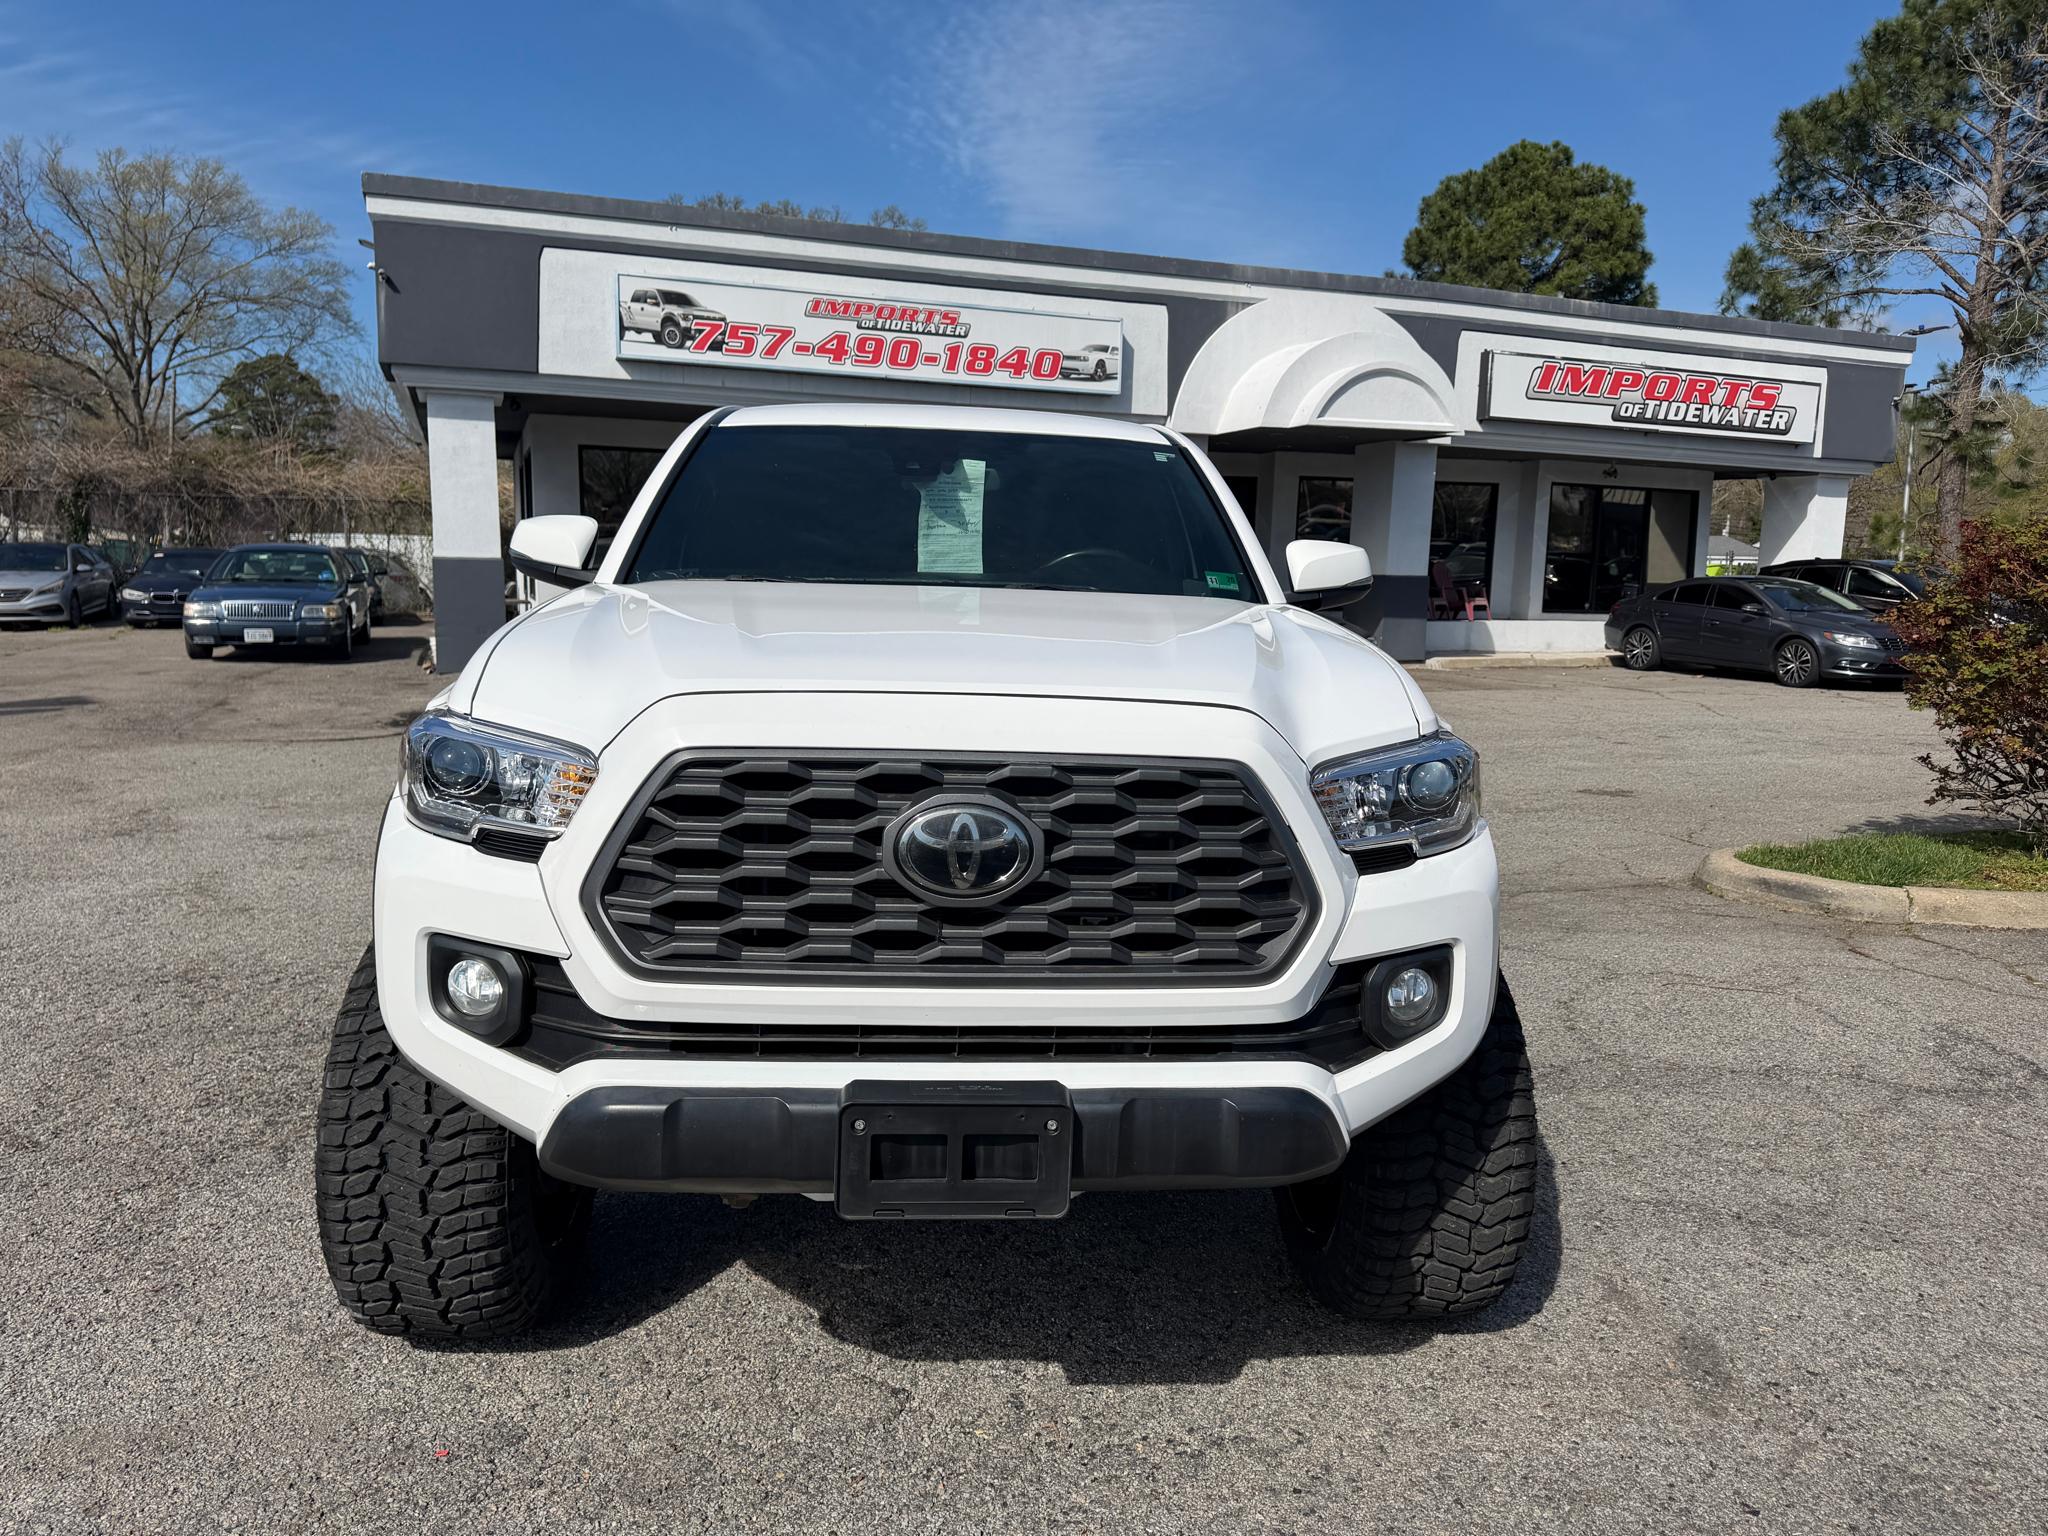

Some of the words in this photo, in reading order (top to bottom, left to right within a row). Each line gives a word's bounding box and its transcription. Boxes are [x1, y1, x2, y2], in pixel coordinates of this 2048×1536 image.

[809, 298, 961, 326] IMPORTS
[860, 319, 877, 328] OF
[876, 318, 967, 337] TIDEWATER
[690, 320, 1065, 381] 757-490-1840
[1533, 362, 1782, 410] IMPORTS
[1619, 403, 1644, 418] OF
[1643, 402, 1790, 431] TIDEWATER
